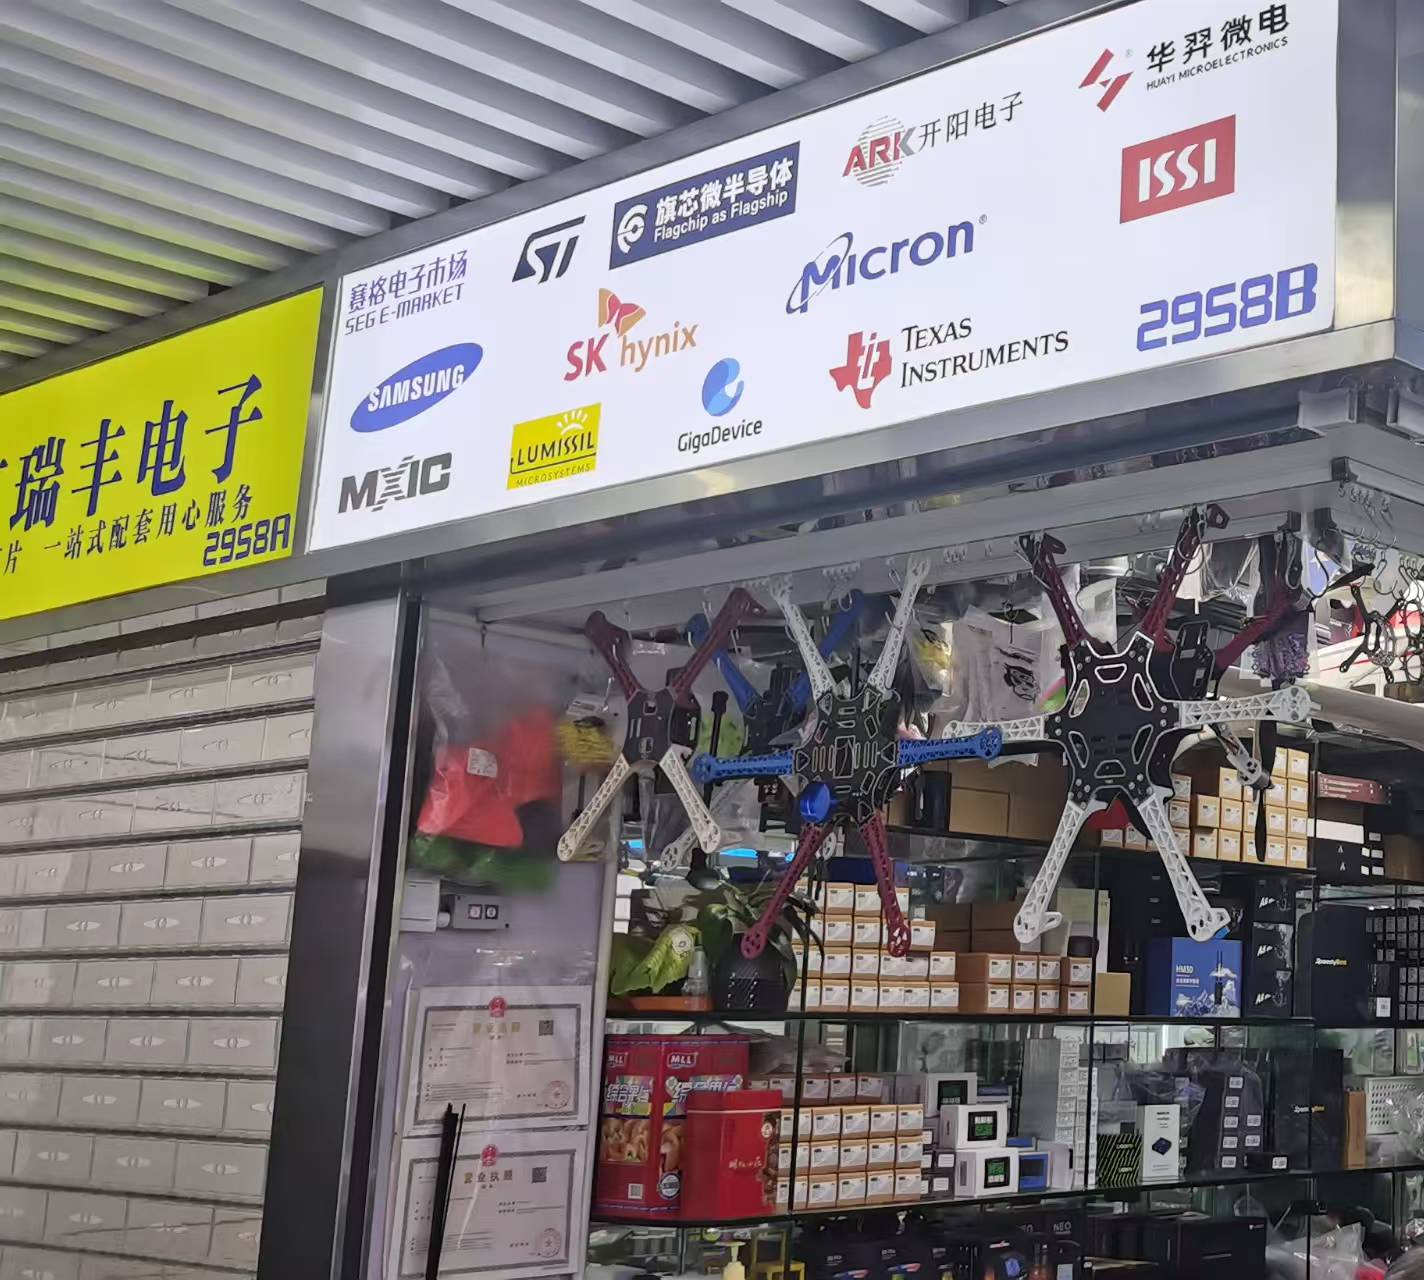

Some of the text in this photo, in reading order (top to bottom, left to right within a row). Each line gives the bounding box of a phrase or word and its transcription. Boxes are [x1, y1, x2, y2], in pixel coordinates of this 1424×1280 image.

[1146, 3, 1290, 73] 华羿微电
[1146, 36, 1288, 91] HUAYI MICROELECTRONICS
[918, 91, 1024, 151] 开阳电子
[842, 126, 917, 177] ARK
[1138, 138, 1217, 203] ISSI
[654, 157, 794, 227] 旗芯微半导体
[654, 189, 788, 243] Flagchip as Flagship
[348, 250, 468, 314] 赛格电子市场
[788, 220, 974, 314] Micron
[345, 283, 464, 335] SEG E-MARKET
[901, 317, 972, 352] TEXAS
[1137, 262, 1318, 352] 2958B
[564, 320, 699, 381] SK hynix
[900, 331, 1069, 388] INSTRUMENTS
[367, 364, 465, 412] SAMSUNG
[0, 374, 263, 532] 瑞丰电子
[517, 431, 595, 466] LUMISSIL
[678, 418, 763, 454] GigaDevice
[338, 452, 452, 513] MXIC
[516, 463, 591, 488] MICROSYSTEMS
[0, 484, 252, 575] 片 一站式配套用心服务
[203, 513, 291, 567] 2958A
